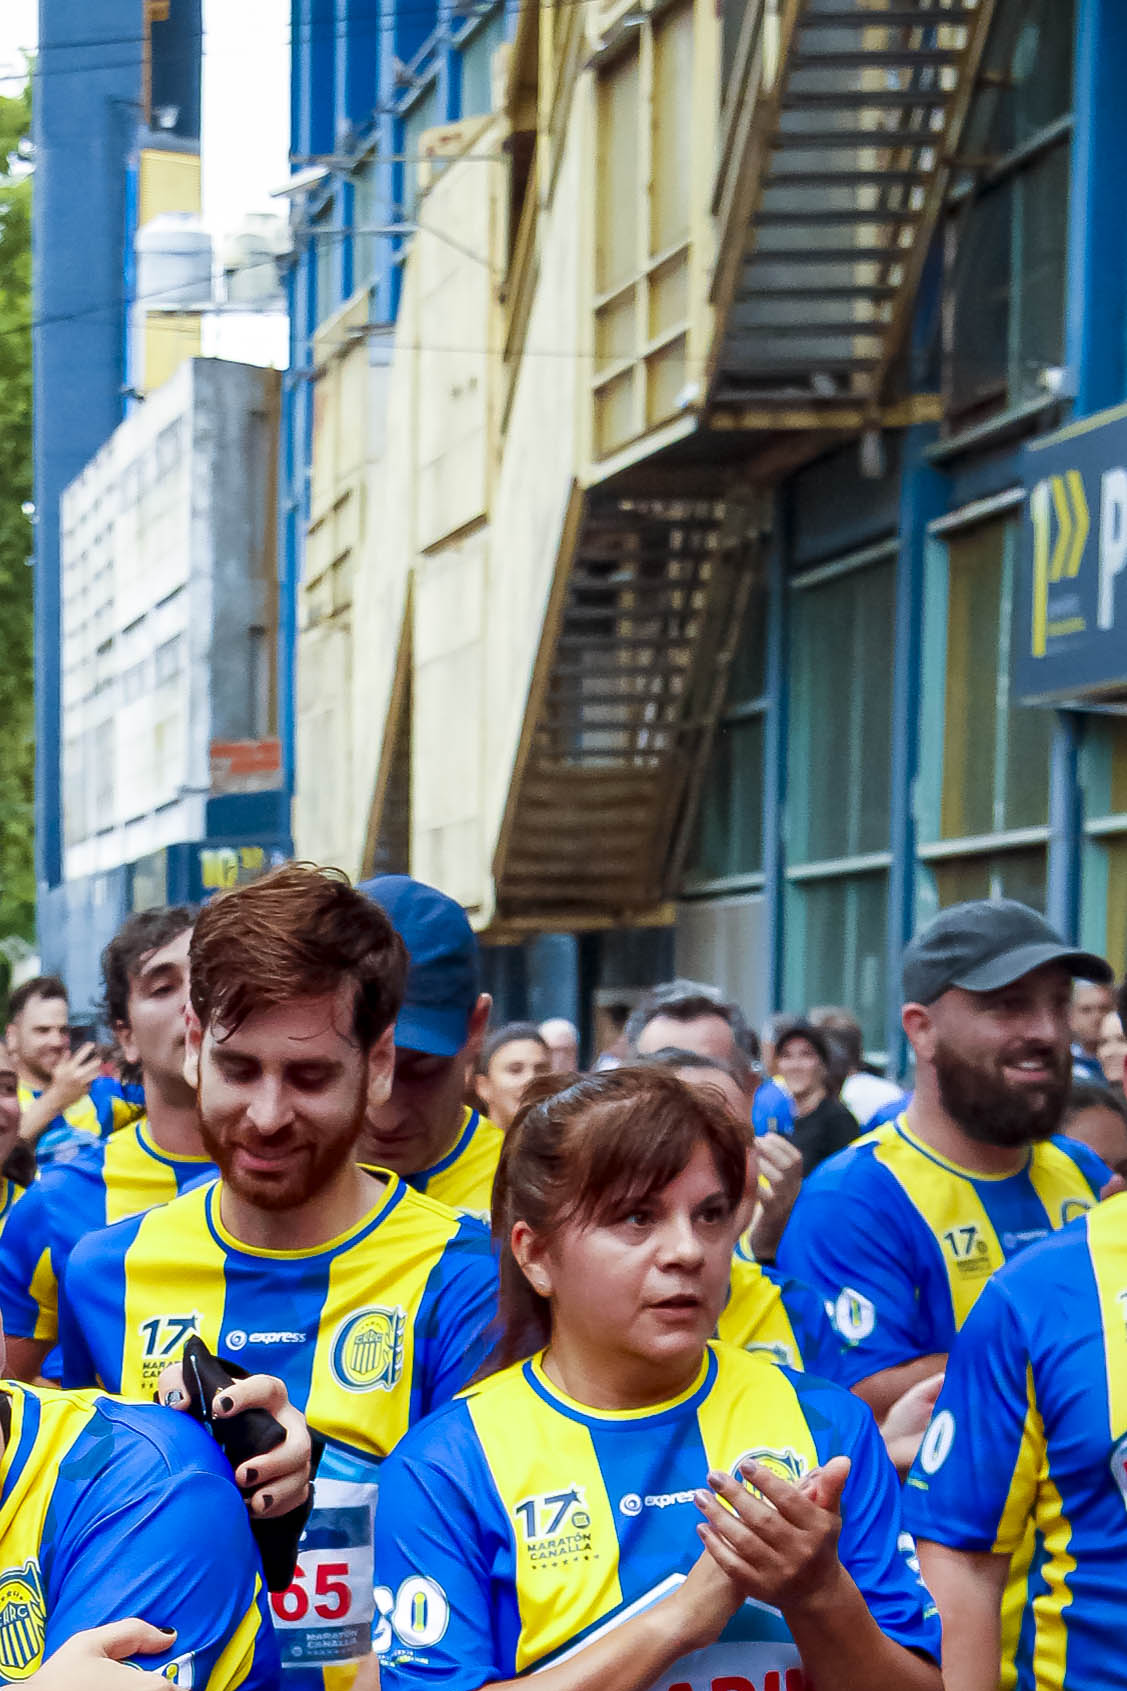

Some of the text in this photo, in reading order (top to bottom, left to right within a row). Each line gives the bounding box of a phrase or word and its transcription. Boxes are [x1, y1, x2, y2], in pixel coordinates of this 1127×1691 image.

[943, 1225, 979, 1257] 17
[141, 1312, 200, 1357] 17
[248, 1331, 307, 1345] express
[515, 1486, 585, 1540] 17
[527, 1532, 592, 1552] MARATÓN
[530, 1543, 592, 1561] CANALLA
